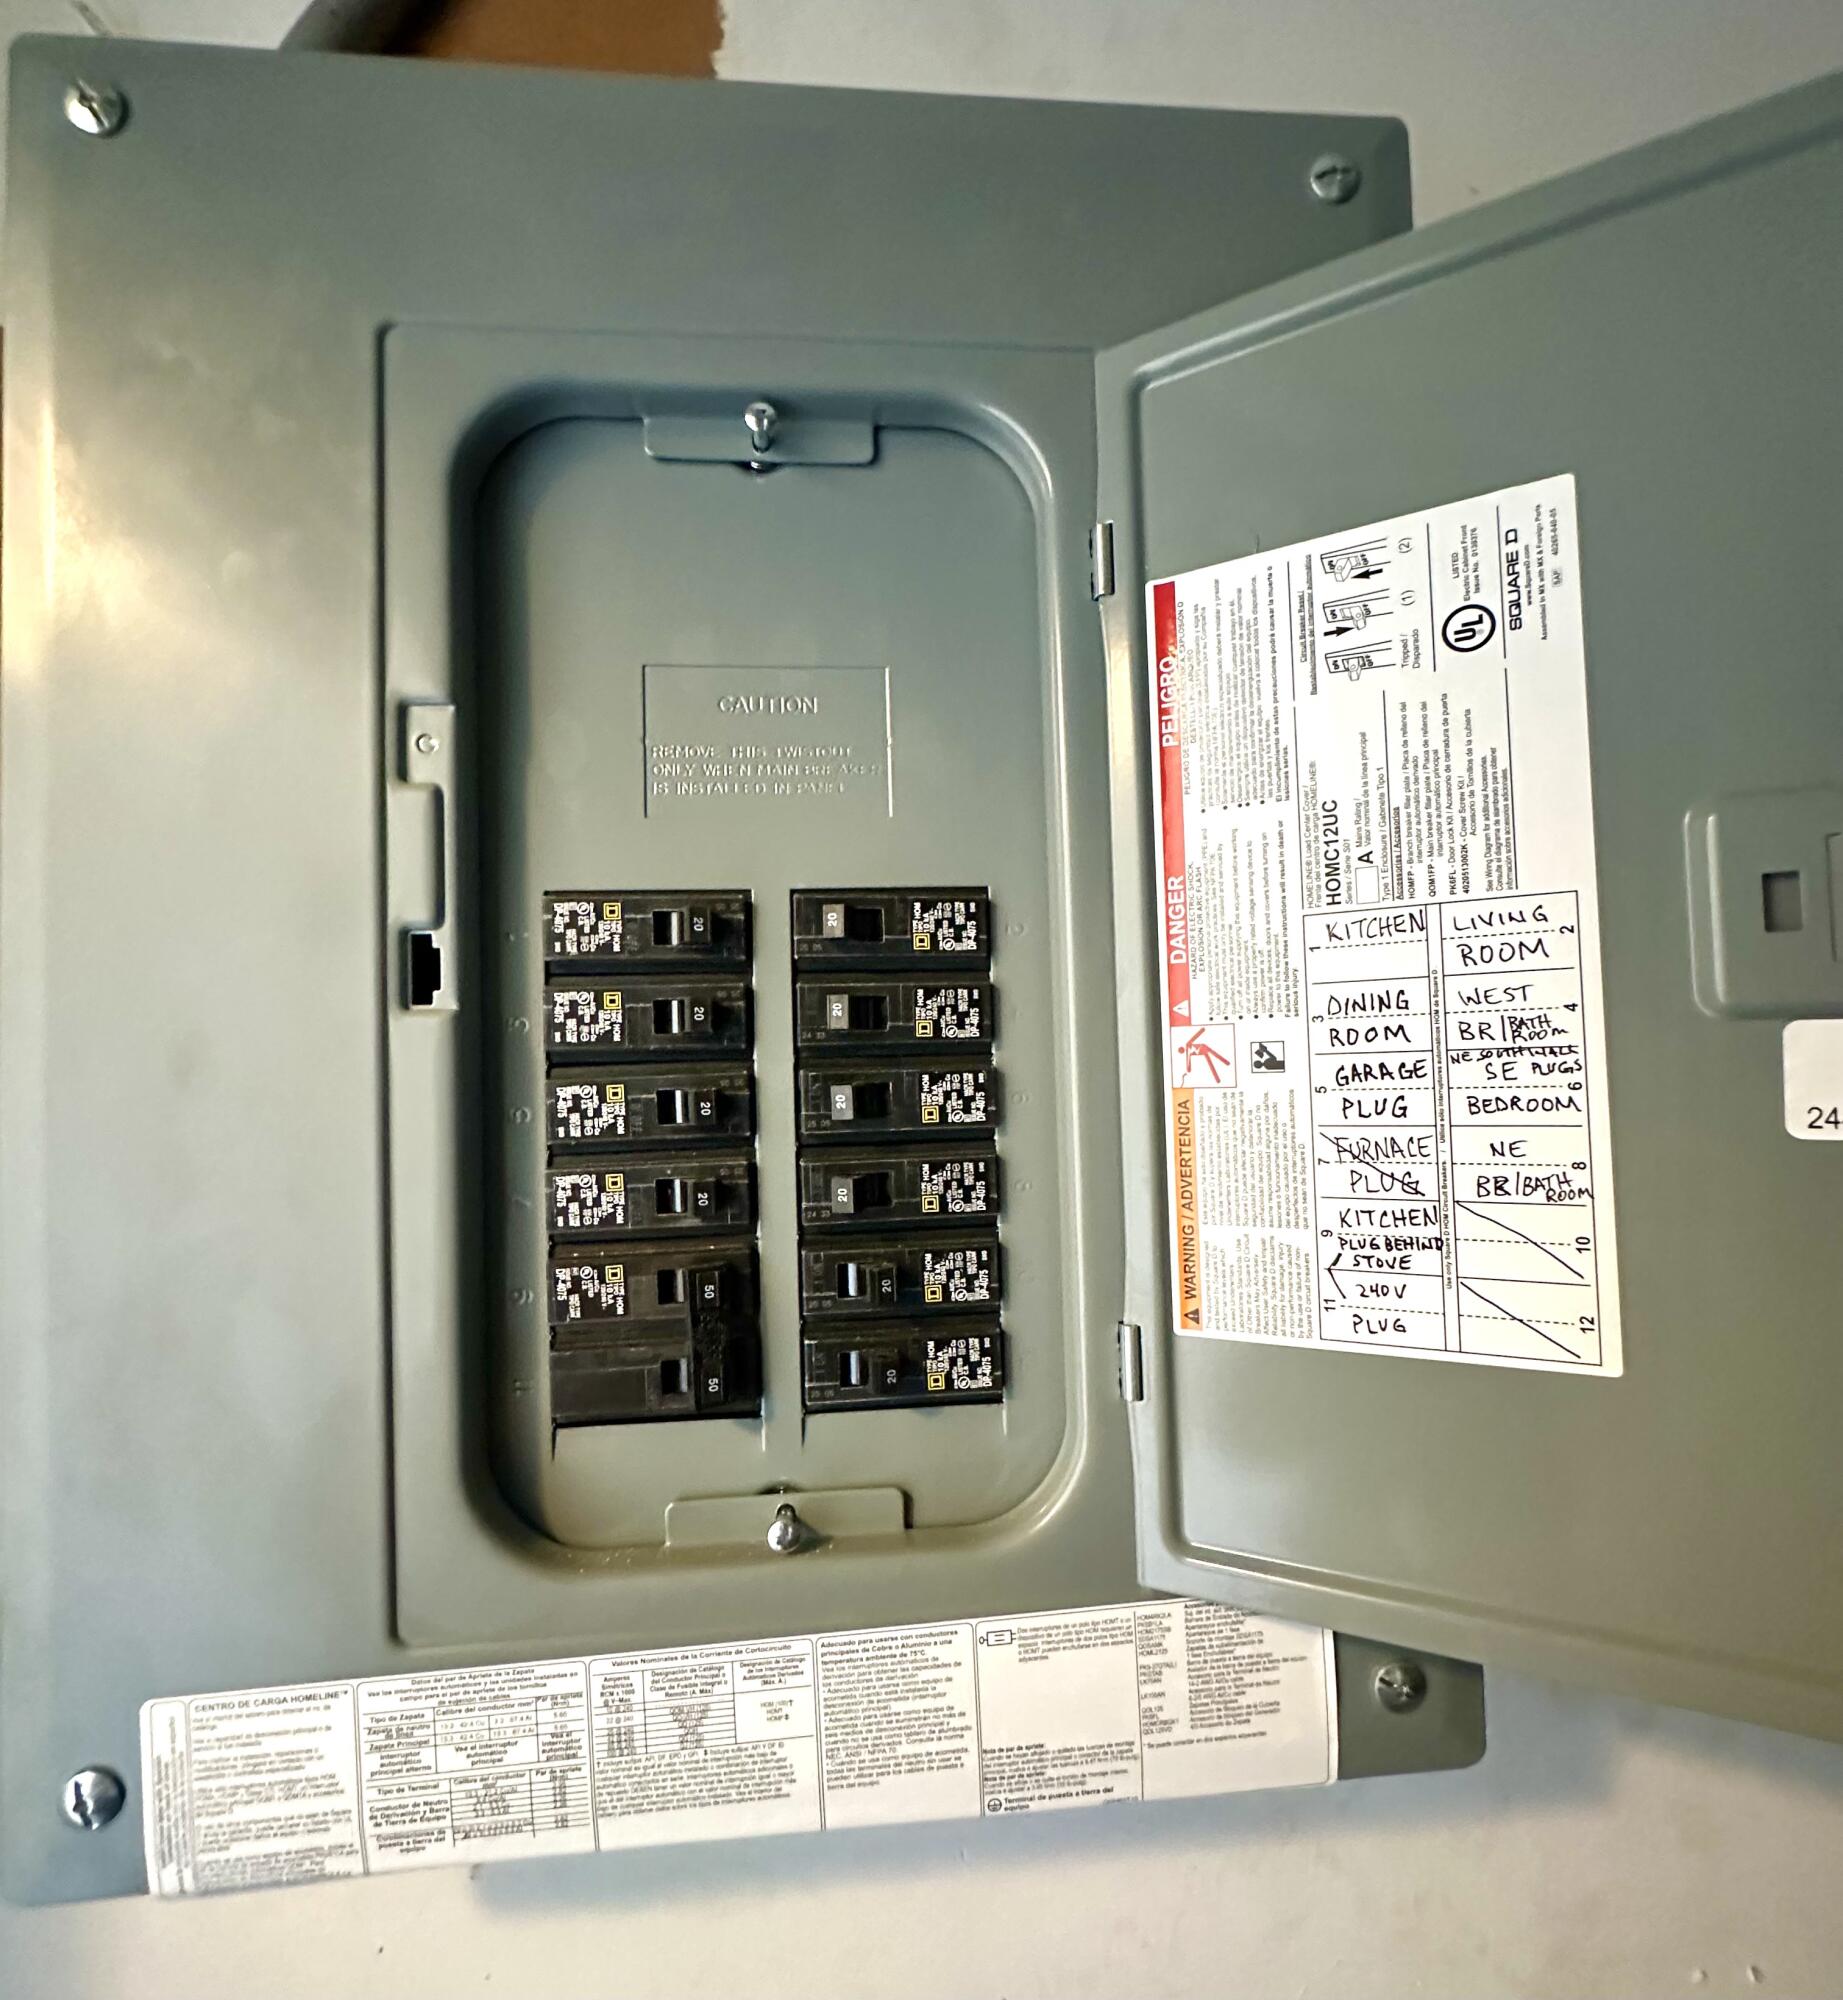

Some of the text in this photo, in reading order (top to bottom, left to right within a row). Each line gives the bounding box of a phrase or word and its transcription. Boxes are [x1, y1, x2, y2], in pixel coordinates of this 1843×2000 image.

[1398, 537, 1413, 554] (2)
[1451, 552, 1460, 580] LISTED
[1460, 524, 1471, 602] Electric Cabinet Front
[1504, 528, 1523, 631] SQUARE D
[1400, 589, 1416, 607] (1)
[1453, 613, 1484, 643] UL
[1400, 638, 1411, 669] Tripped
[1411, 628, 1421, 669] Disparado
[717, 695, 819, 715] CAUTION
[1159, 653, 1180, 748] PELIGRO
[757, 763, 799, 777] MAIN
[653, 781, 669, 796] IS
[774, 781, 790, 795] IN
[1376, 773, 1386, 791] Tipo
[1302, 789, 1311, 812] Cover
[1378, 792, 1387, 828] Gabinete
[1312, 812, 1320, 834] carga
[1354, 802, 1363, 826] Rating
[1303, 813, 1312, 839] Center
[1312, 834, 1320, 845] de
[1355, 826, 1363, 848] Mains
[1304, 839, 1313, 859] Load
[1313, 845, 1321, 870] centro
[1321, 800, 1342, 906] HOMC12UC
[1357, 850, 1374, 865] A
[1380, 834, 1389, 874] Enclosure
[1195, 866, 1203, 893] FLASH
[1314, 870, 1322, 883] del
[1314, 883, 1322, 908] Frente
[1381, 882, 1392, 902] Type
[693, 917, 704, 932] 20
[828, 912, 838, 928] 20
[1167, 875, 1187, 964] DANGER
[1196, 913, 1204, 926] OR
[1326, 909, 1425, 941] KITCHEN
[1453, 904, 1548, 931] LIVING
[1559, 924, 1575, 935] 2
[1197, 927, 1206, 973] EXPLOSION
[1456, 938, 1549, 967] ROOM
[1327, 989, 1409, 1016] DINING
[1458, 984, 1533, 1006] WEST
[694, 1006, 704, 1021] 20
[832, 1002, 842, 1017] 20
[1563, 1003, 1578, 1012] 4
[1311, 1015, 1325, 1023] 3
[1329, 1024, 1411, 1047] ROOM
[1450, 1052, 1473, 1064] NE
[1335, 1059, 1427, 1087] GARAGE
[1485, 1059, 1583, 1080] SE PLUGS
[1314, 1085, 1328, 1094] 5
[1568, 1082, 1582, 1090] 6
[701, 1101, 711, 1116] 20
[836, 1094, 846, 1109] 20
[1342, 1095, 1408, 1119] PLUG
[1467, 1095, 1582, 1115] BEDROOM
[1807, 1106, 1843, 1130] 24
[1333, 1135, 1433, 1166] FURNACE
[1490, 1140, 1528, 1158] NE
[1317, 1157, 1331, 1166] 7
[1571, 1161, 1587, 1170] 8
[1350, 1168, 1421, 1195] PLUG
[698, 1192, 708, 1206] 20
[838, 1188, 848, 1203] 20
[1177, 1099, 1197, 1300] WARNING / ADVERTENCIA
[1546, 1187, 1595, 1203] ROOM
[1339, 1205, 1439, 1228] KITCHEN
[1320, 1229, 1333, 1237] 9
[1338, 1236, 1444, 1252] PLUG BEHIND
[1575, 1236, 1591, 1254] 10
[1353, 1255, 1412, 1270] STOVE
[704, 1284, 714, 1299] 50
[882, 1279, 892, 1293] 20
[1323, 1299, 1336, 1312] 11
[1353, 1314, 1406, 1334] PLUG
[1578, 1316, 1595, 1334] 12
[709, 1378, 719, 1393] 50
[887, 1369, 897, 1384] 20
[238, 1700, 250, 1709] DE
[253, 1697, 289, 1707] CARGA
